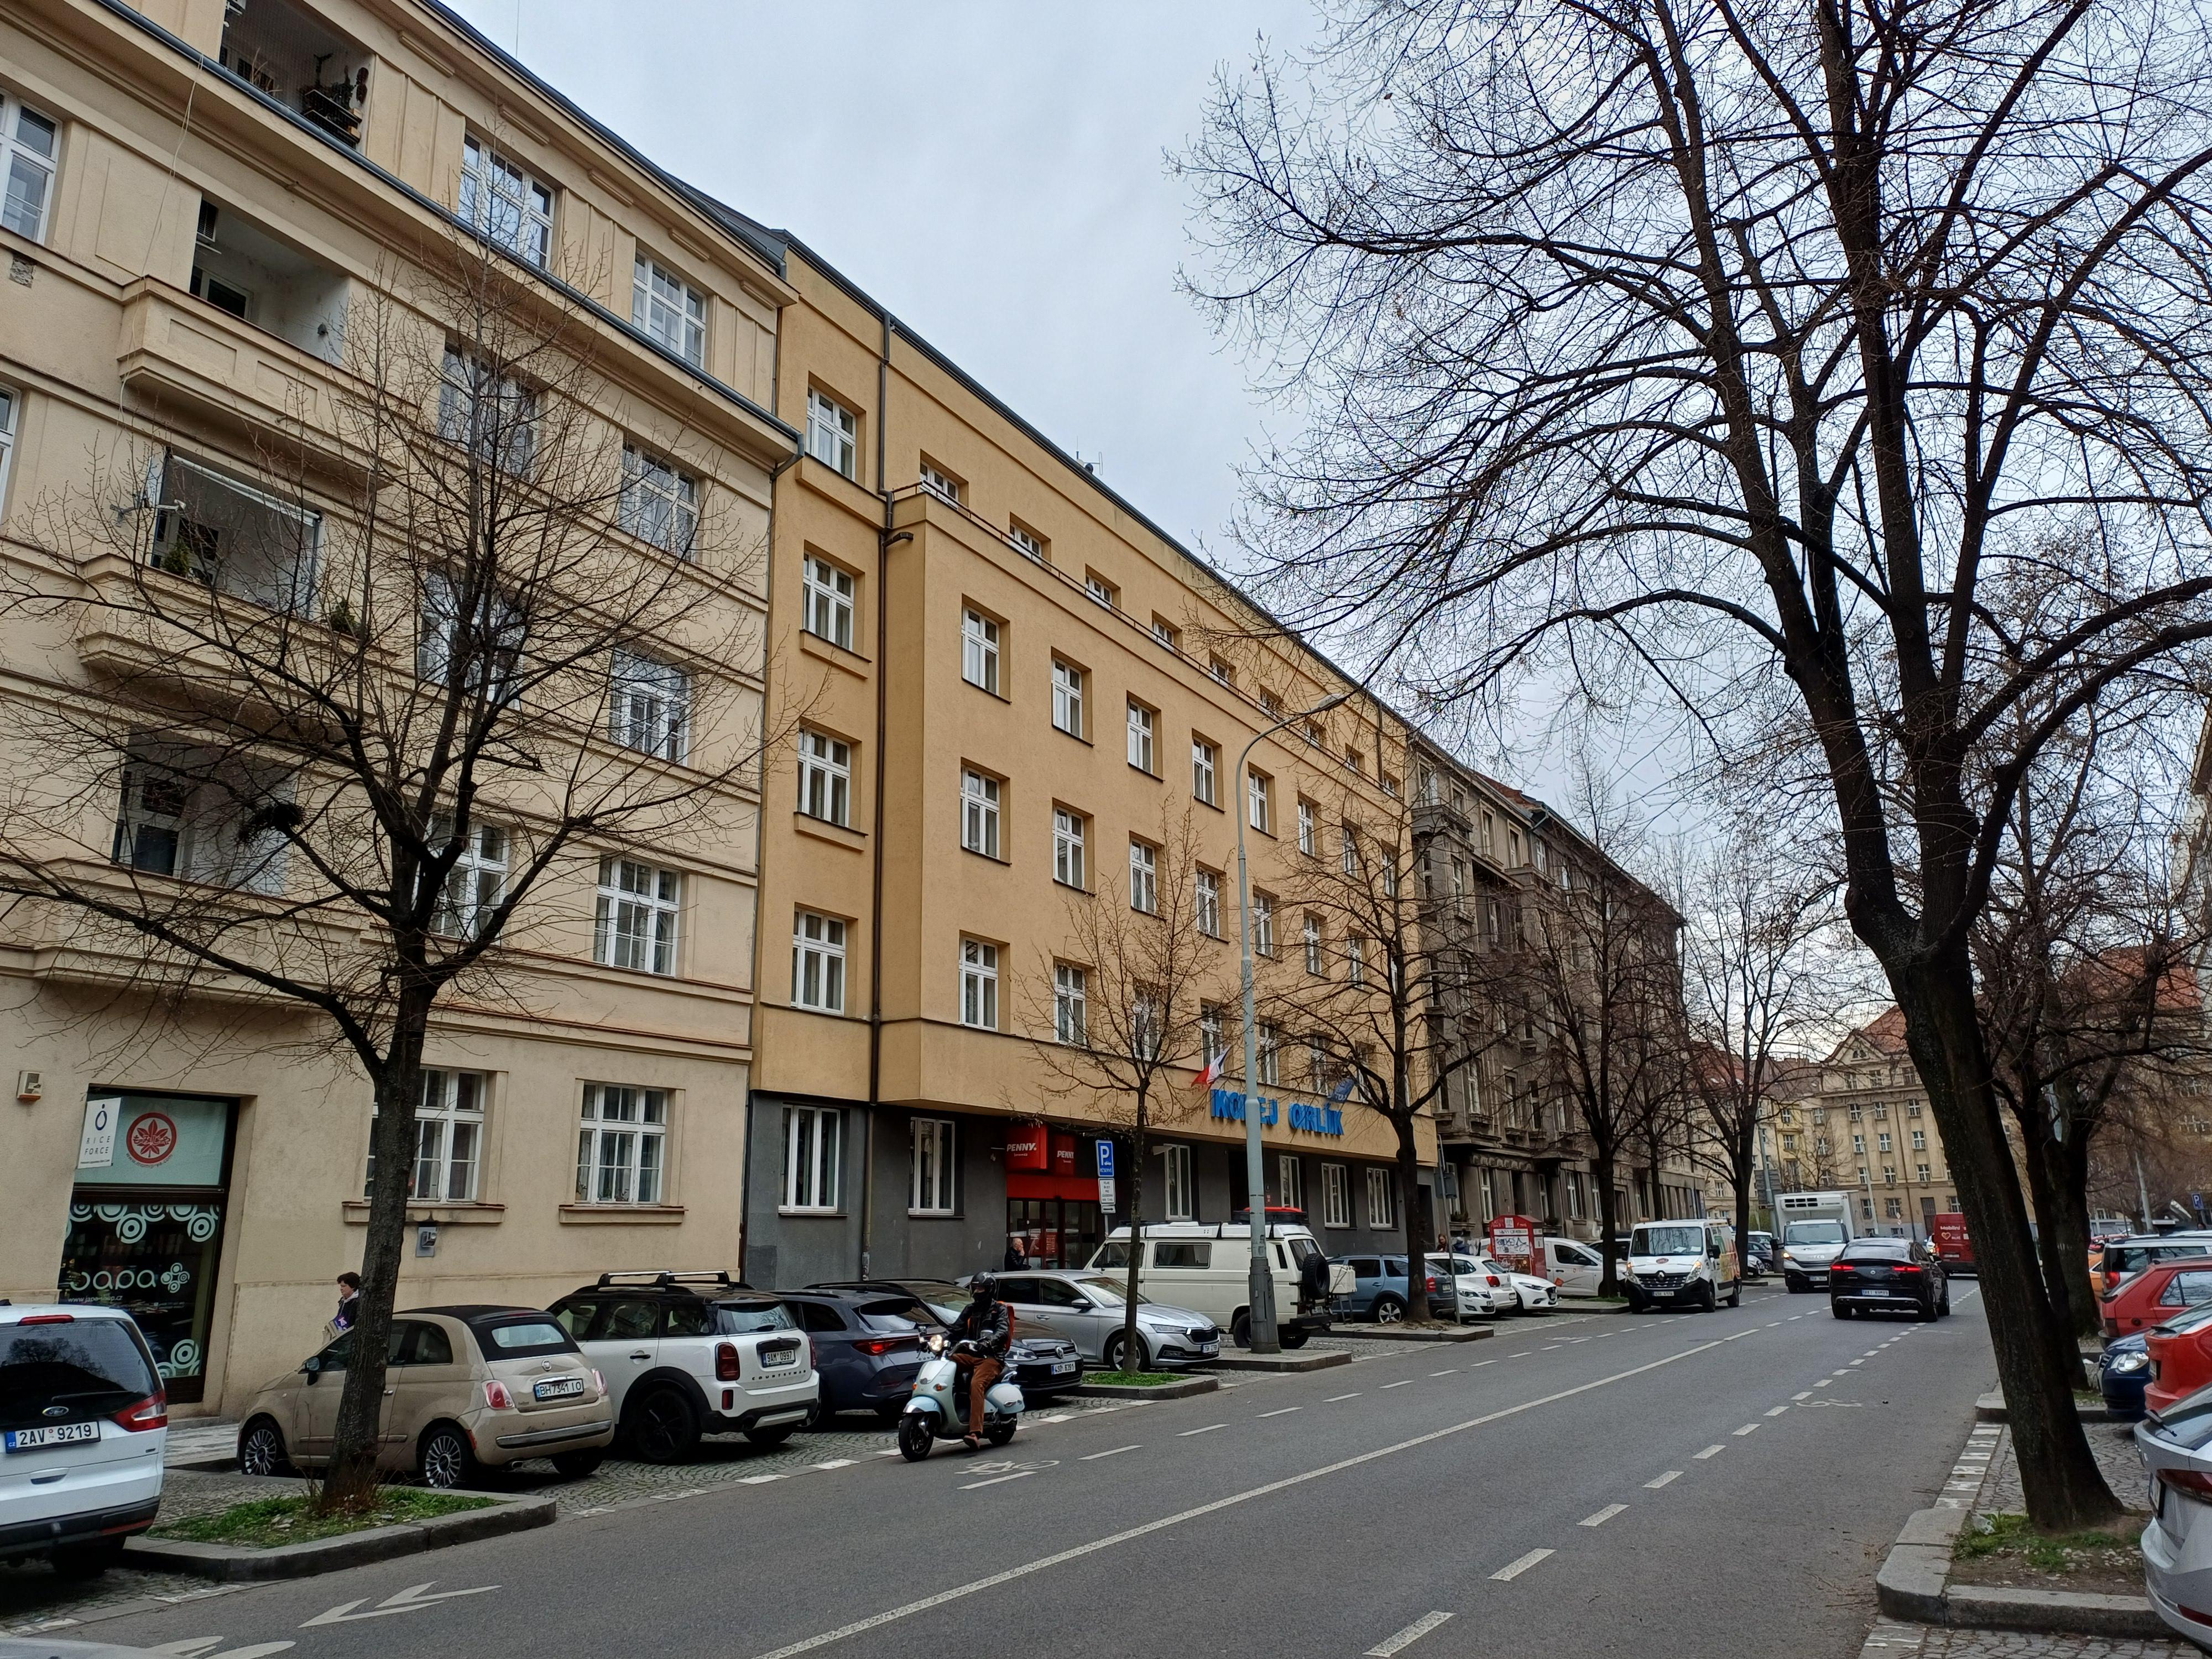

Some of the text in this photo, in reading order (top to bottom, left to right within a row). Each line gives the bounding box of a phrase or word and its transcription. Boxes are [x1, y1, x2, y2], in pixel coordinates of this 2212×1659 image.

[1210, 1089, 1278, 1126] KOEJ
[86, 1135, 111, 1145] RICE
[85, 1146, 109, 1155] FORCE
[1100, 1146, 1109, 1166] P
[19, 1430, 45, 1446] 2AV
[57, 1424, 92, 1441] 9219
